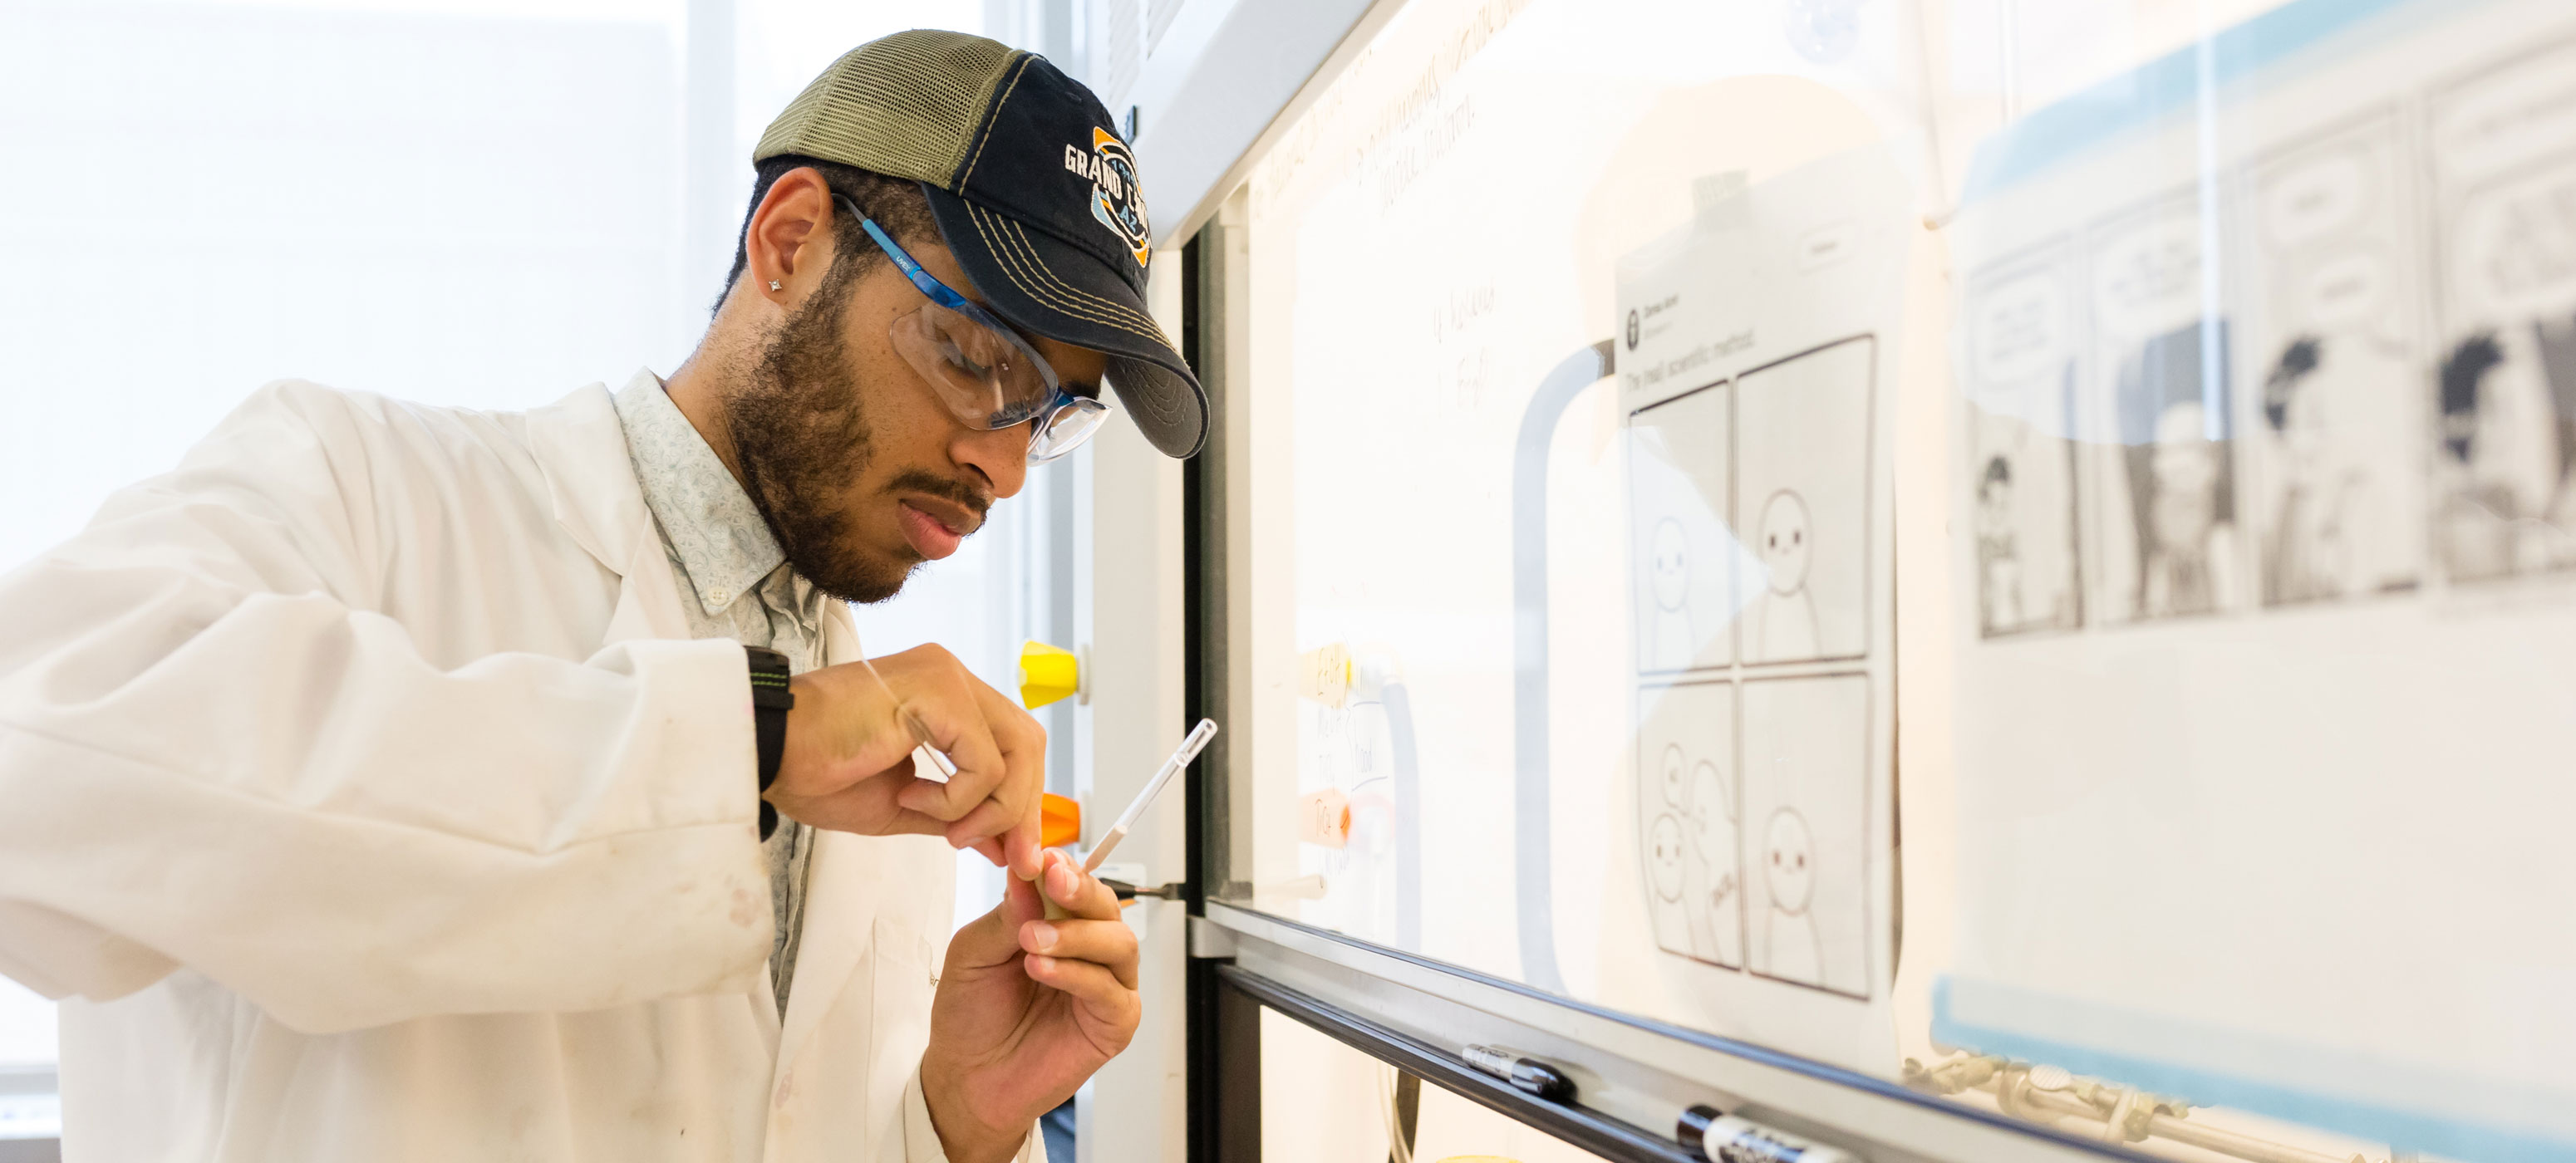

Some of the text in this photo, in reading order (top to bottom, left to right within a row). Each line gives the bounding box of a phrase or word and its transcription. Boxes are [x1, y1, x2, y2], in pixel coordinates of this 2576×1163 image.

[1064, 143, 1123, 200] GRAND
[1119, 205, 1138, 233] AZ
[896, 255, 911, 272] UVEX
[1668, 344, 1709, 378] scientific
